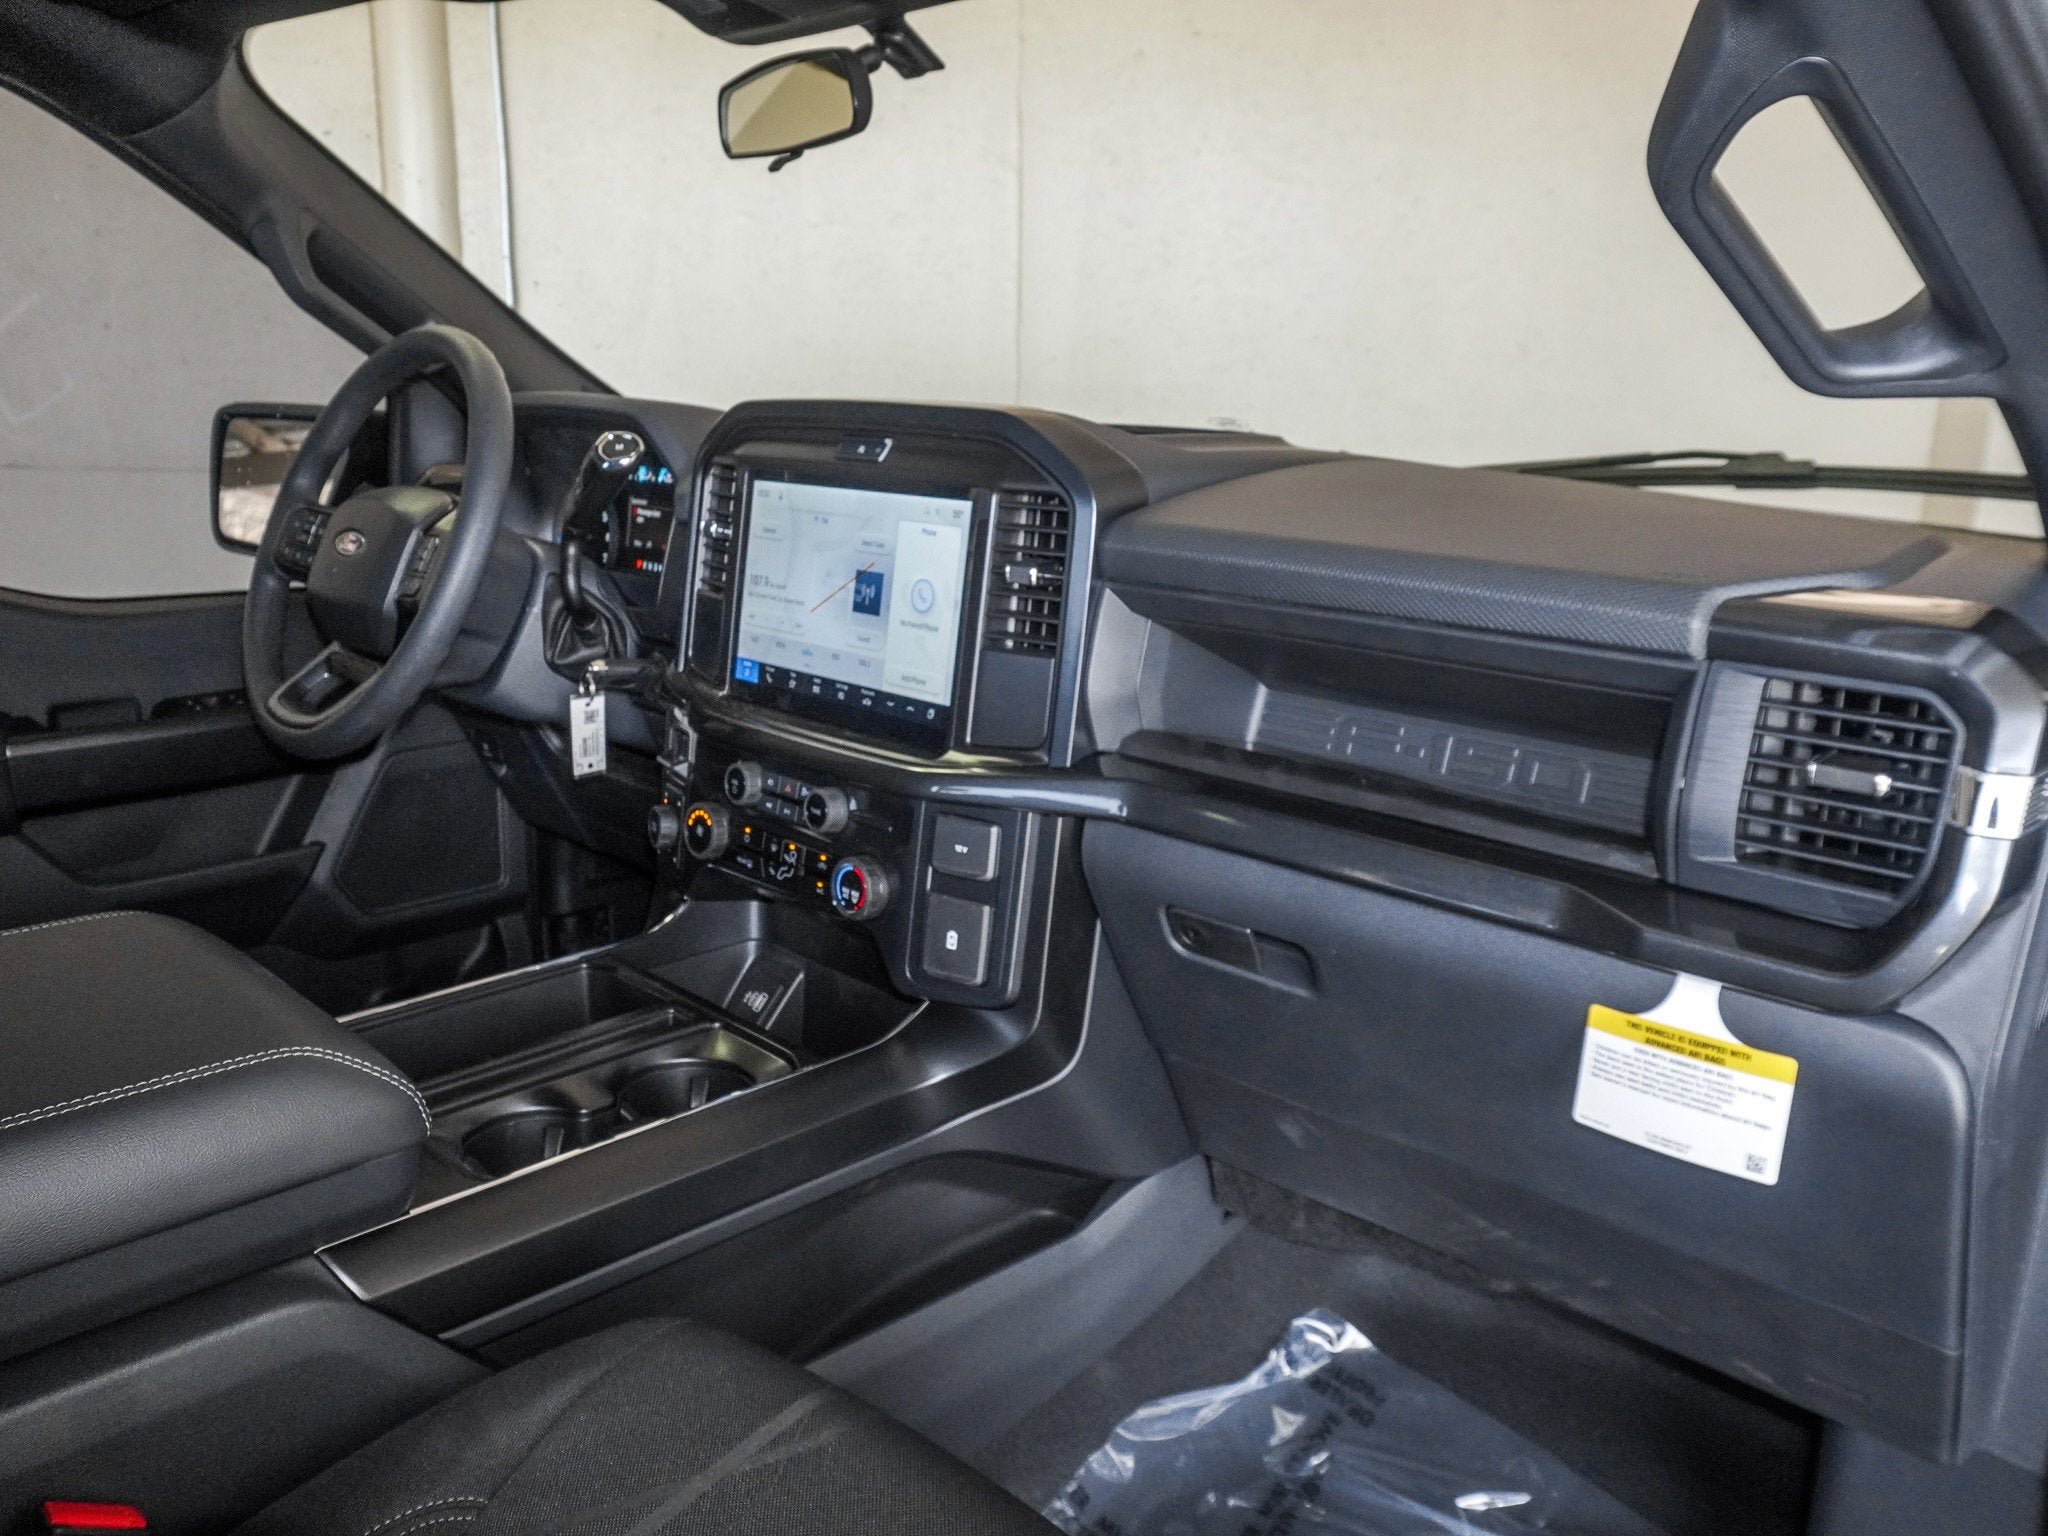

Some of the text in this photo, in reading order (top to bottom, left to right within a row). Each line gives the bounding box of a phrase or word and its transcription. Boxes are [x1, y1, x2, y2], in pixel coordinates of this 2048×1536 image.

[1645, 1025, 1676, 1040] VEHICLE
[1688, 1038, 1729, 1055] EQUIPPED
[1730, 1049, 1752, 1062] WITH
[1645, 1037, 1687, 1055] ADVANCED
